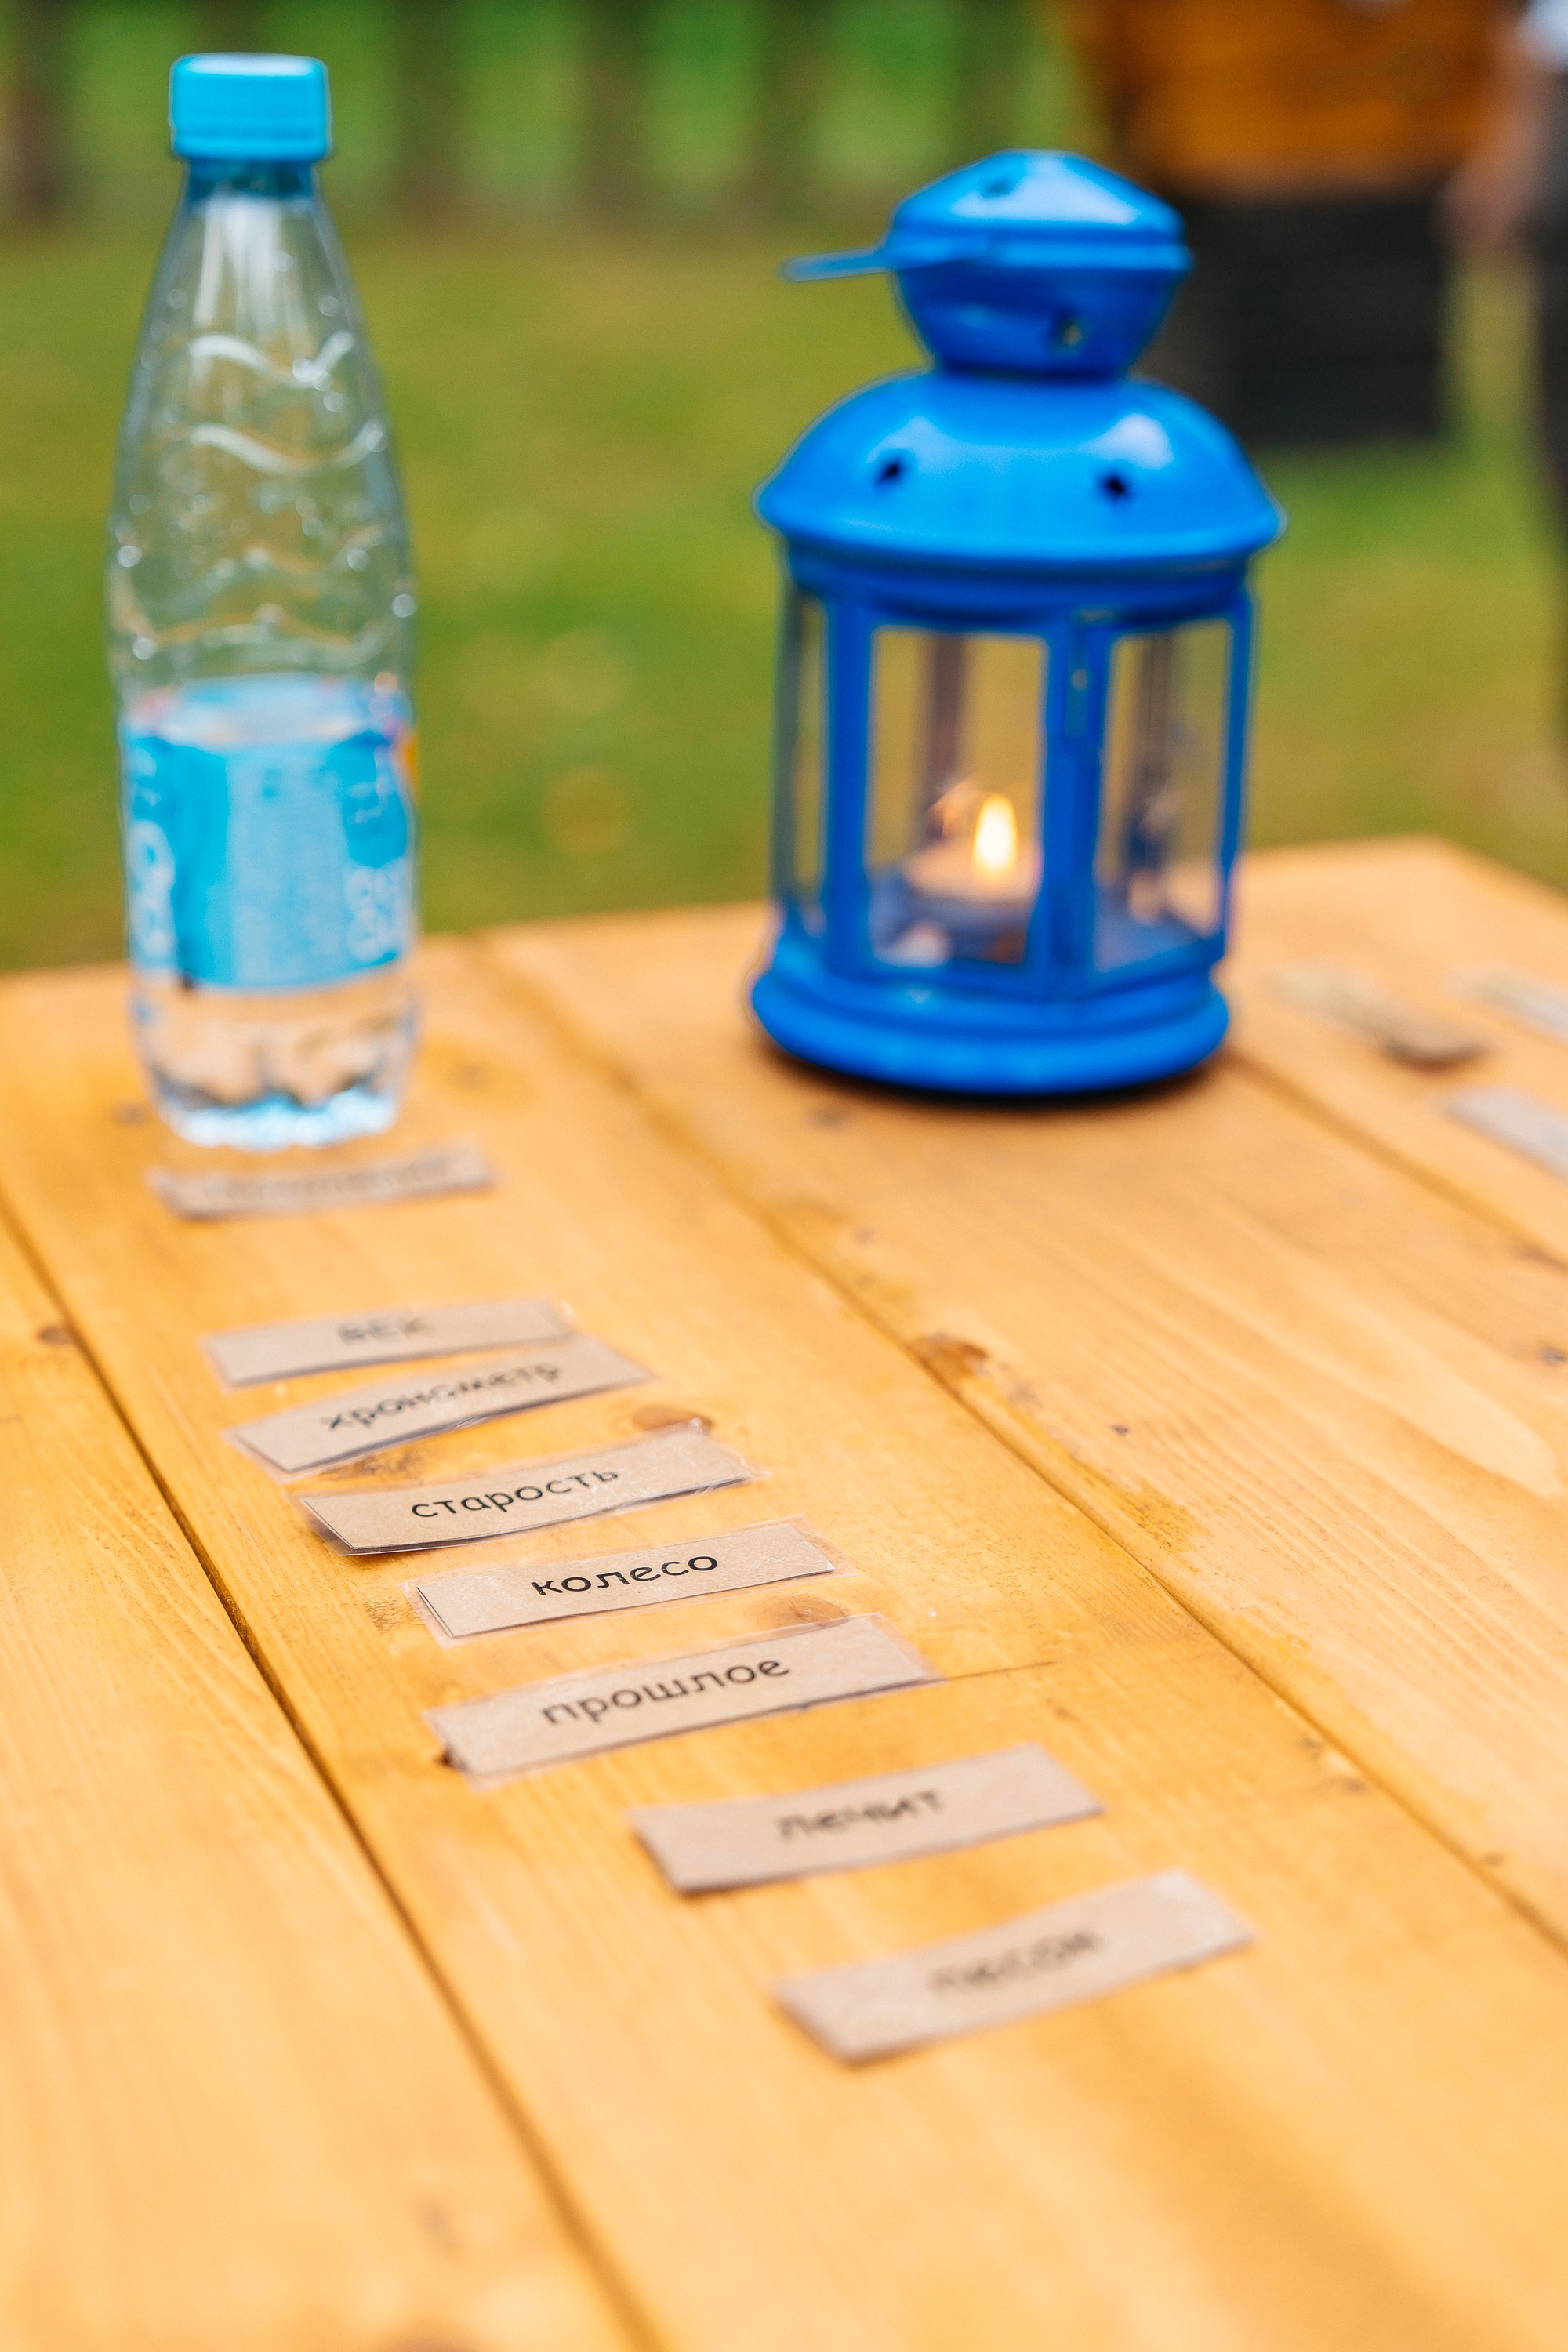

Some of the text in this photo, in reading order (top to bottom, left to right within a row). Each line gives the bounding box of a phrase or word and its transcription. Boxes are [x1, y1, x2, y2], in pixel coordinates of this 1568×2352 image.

[320, 1363, 561, 1432] хронометр
[410, 1468, 619, 1519] старость
[530, 1555, 718, 1596] колесо
[541, 1659, 790, 1725] прошлое
[778, 1789, 942, 1840] лечит
